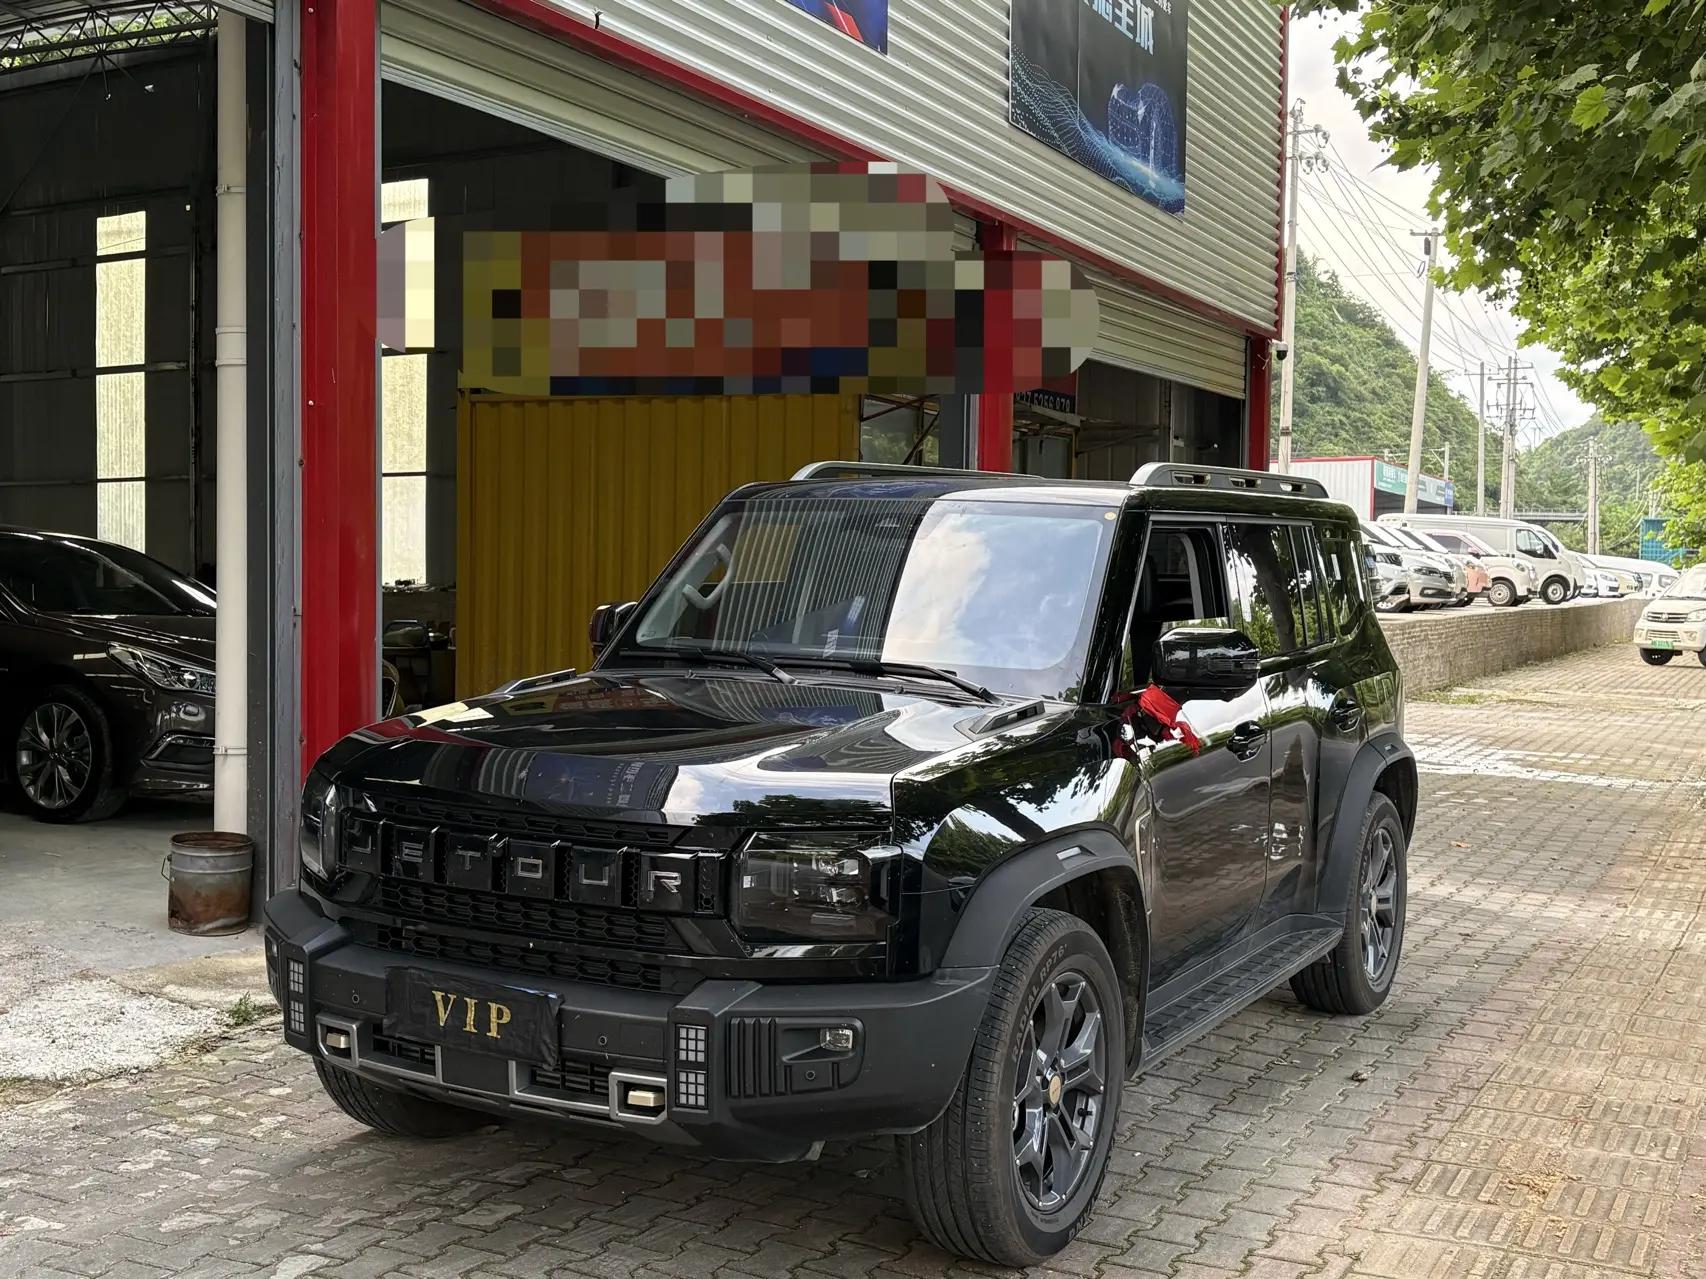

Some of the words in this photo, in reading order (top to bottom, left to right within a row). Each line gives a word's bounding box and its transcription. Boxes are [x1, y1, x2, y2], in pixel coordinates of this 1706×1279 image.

[351, 835, 682, 894] JETOUR
[432, 990, 512, 1039] VIP
[1012, 985, 1039, 1062] RADIAL
